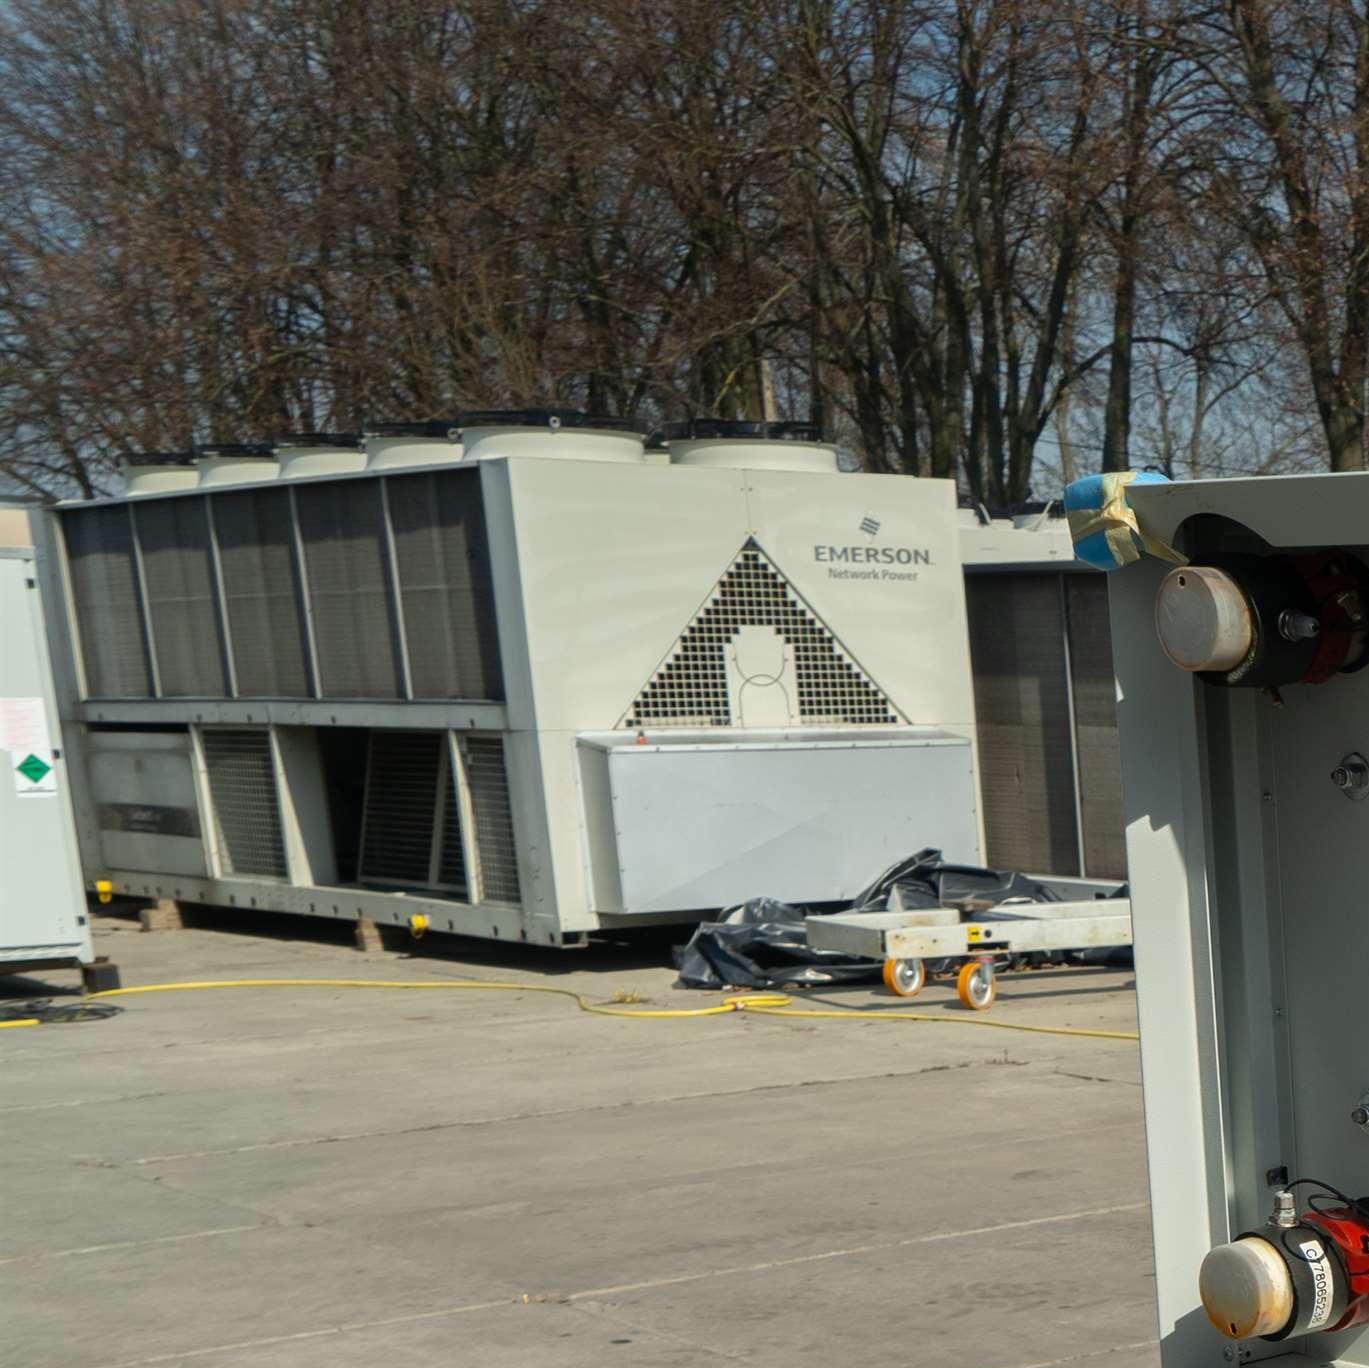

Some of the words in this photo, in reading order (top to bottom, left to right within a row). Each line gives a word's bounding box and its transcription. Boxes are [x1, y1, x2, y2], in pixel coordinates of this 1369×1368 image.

[814, 545, 930, 565] EMERSON
[828, 567, 880, 580] Network
[881, 569, 918, 581] Power
[1305, 1248, 1328, 1324] C78065238
